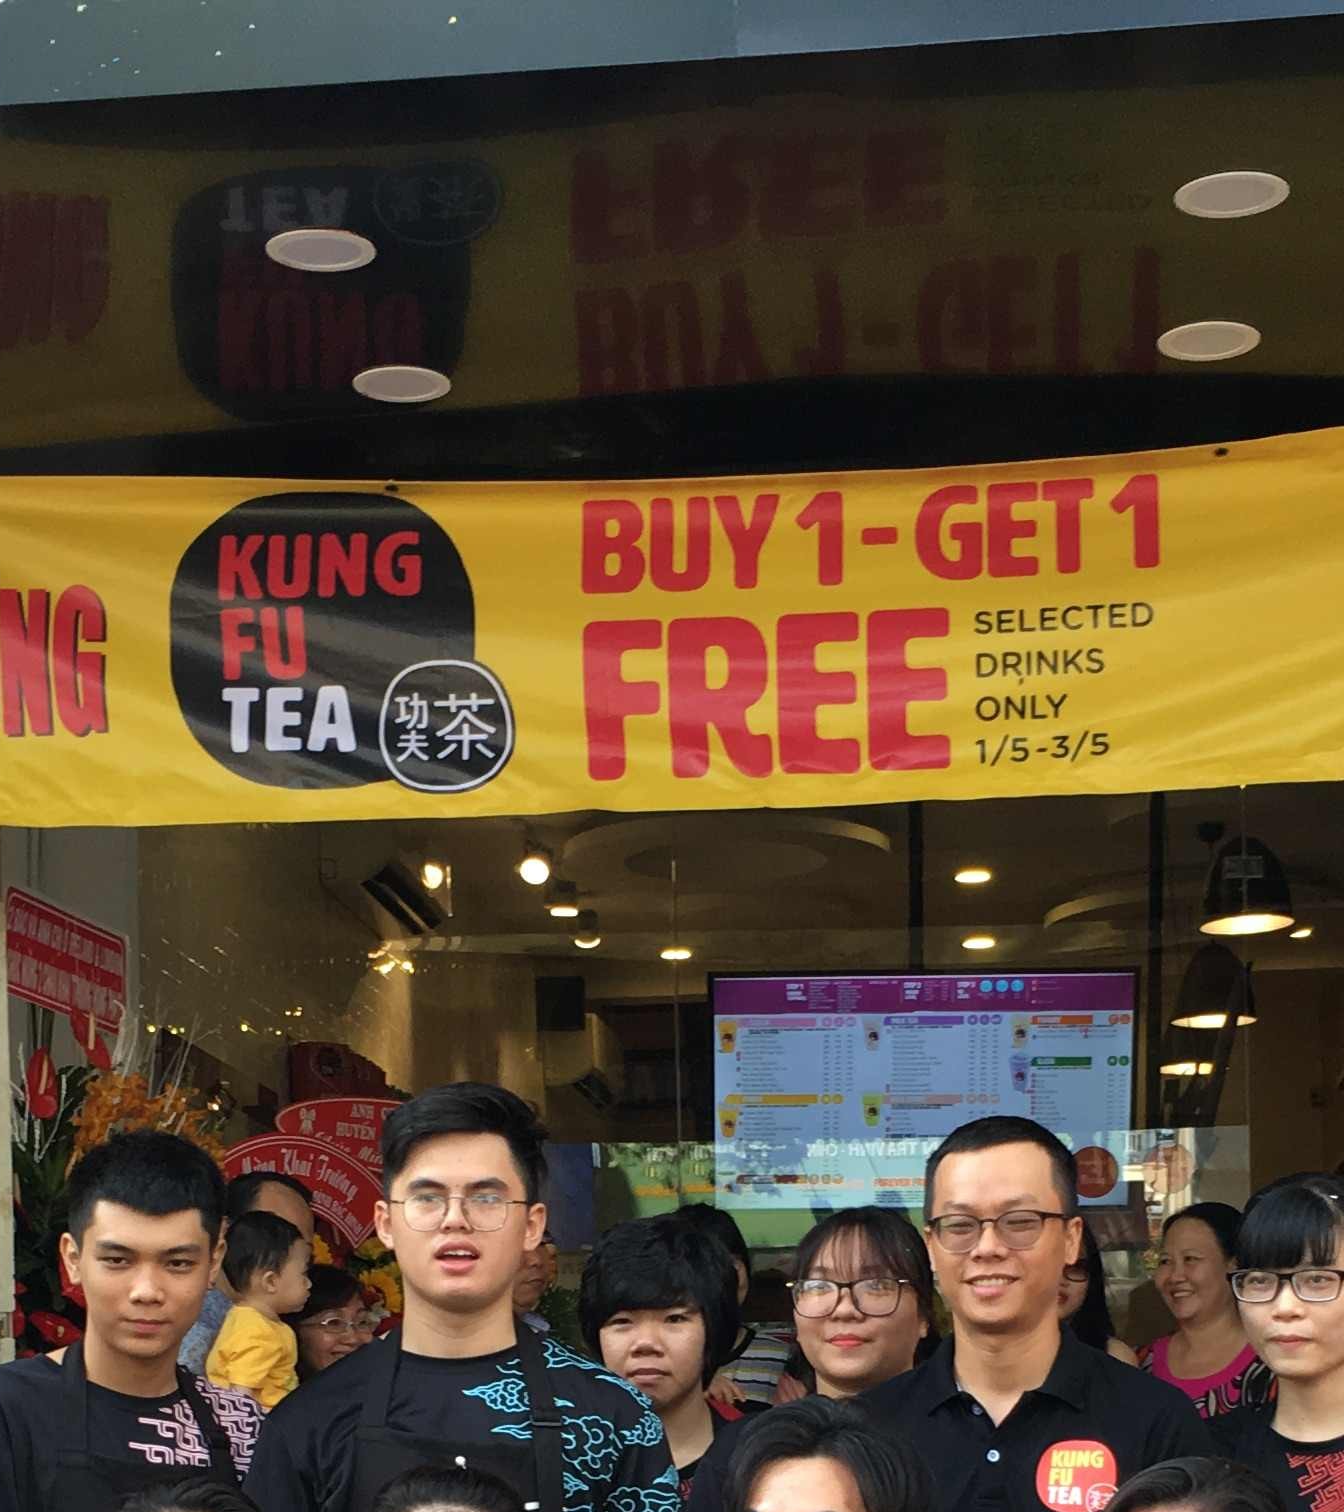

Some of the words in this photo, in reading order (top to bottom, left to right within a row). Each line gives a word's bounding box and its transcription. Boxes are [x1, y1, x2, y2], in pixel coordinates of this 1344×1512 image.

[581, 493, 780, 595] BUY
[795, 491, 844, 587] 1
[915, 478, 1094, 581] GET
[1110, 474, 1161, 570] 1
[217, 531, 423, 600] KUNG
[974, 601, 1154, 636] SELECTED
[218, 606, 308, 680] FU
[975, 647, 1106, 680] DRINKS
[582, 607, 952, 782] FREE
[975, 693, 1068, 723] ONLY
[222, 685, 357, 753] TEA
[975, 731, 1111, 767] 1/5-3/5
[1050, 1449, 1105, 1469] KUNG
[1049, 1467, 1074, 1487] FU
[1047, 1486, 1082, 1506] TEA
